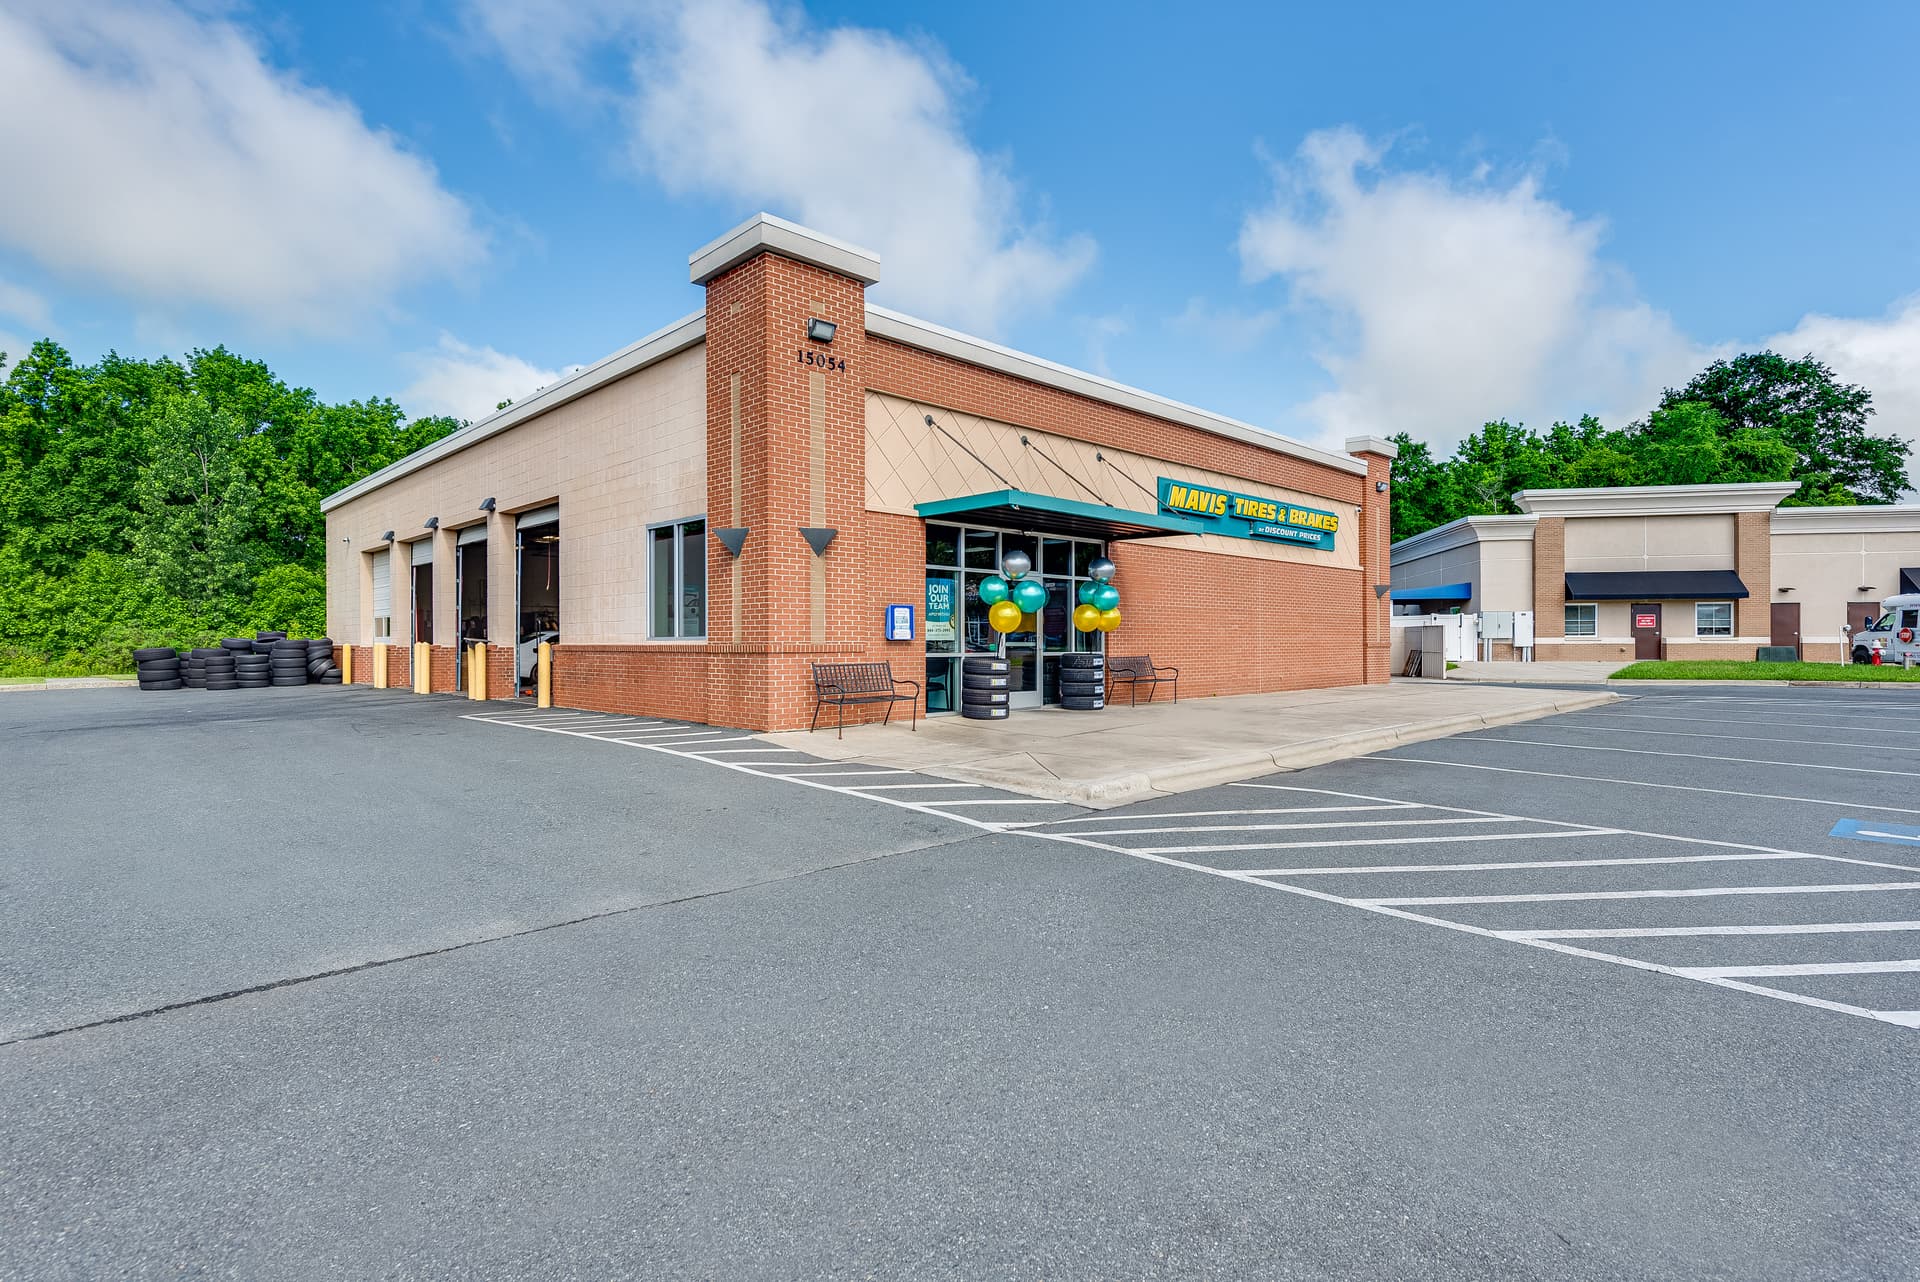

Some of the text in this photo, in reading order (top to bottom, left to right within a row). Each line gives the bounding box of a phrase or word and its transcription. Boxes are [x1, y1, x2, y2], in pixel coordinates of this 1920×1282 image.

[798, 350, 846, 373] 15054
[1169, 486, 1338, 531] MAVIS TIRES & BRAKES
[1265, 526, 1298, 538] DISCOUNT
[1299, 531, 1321, 541] PRICES
[928, 584, 949, 596] JOIN
[930, 594, 949, 603] OUR
[928, 602, 950, 610] TEAM
